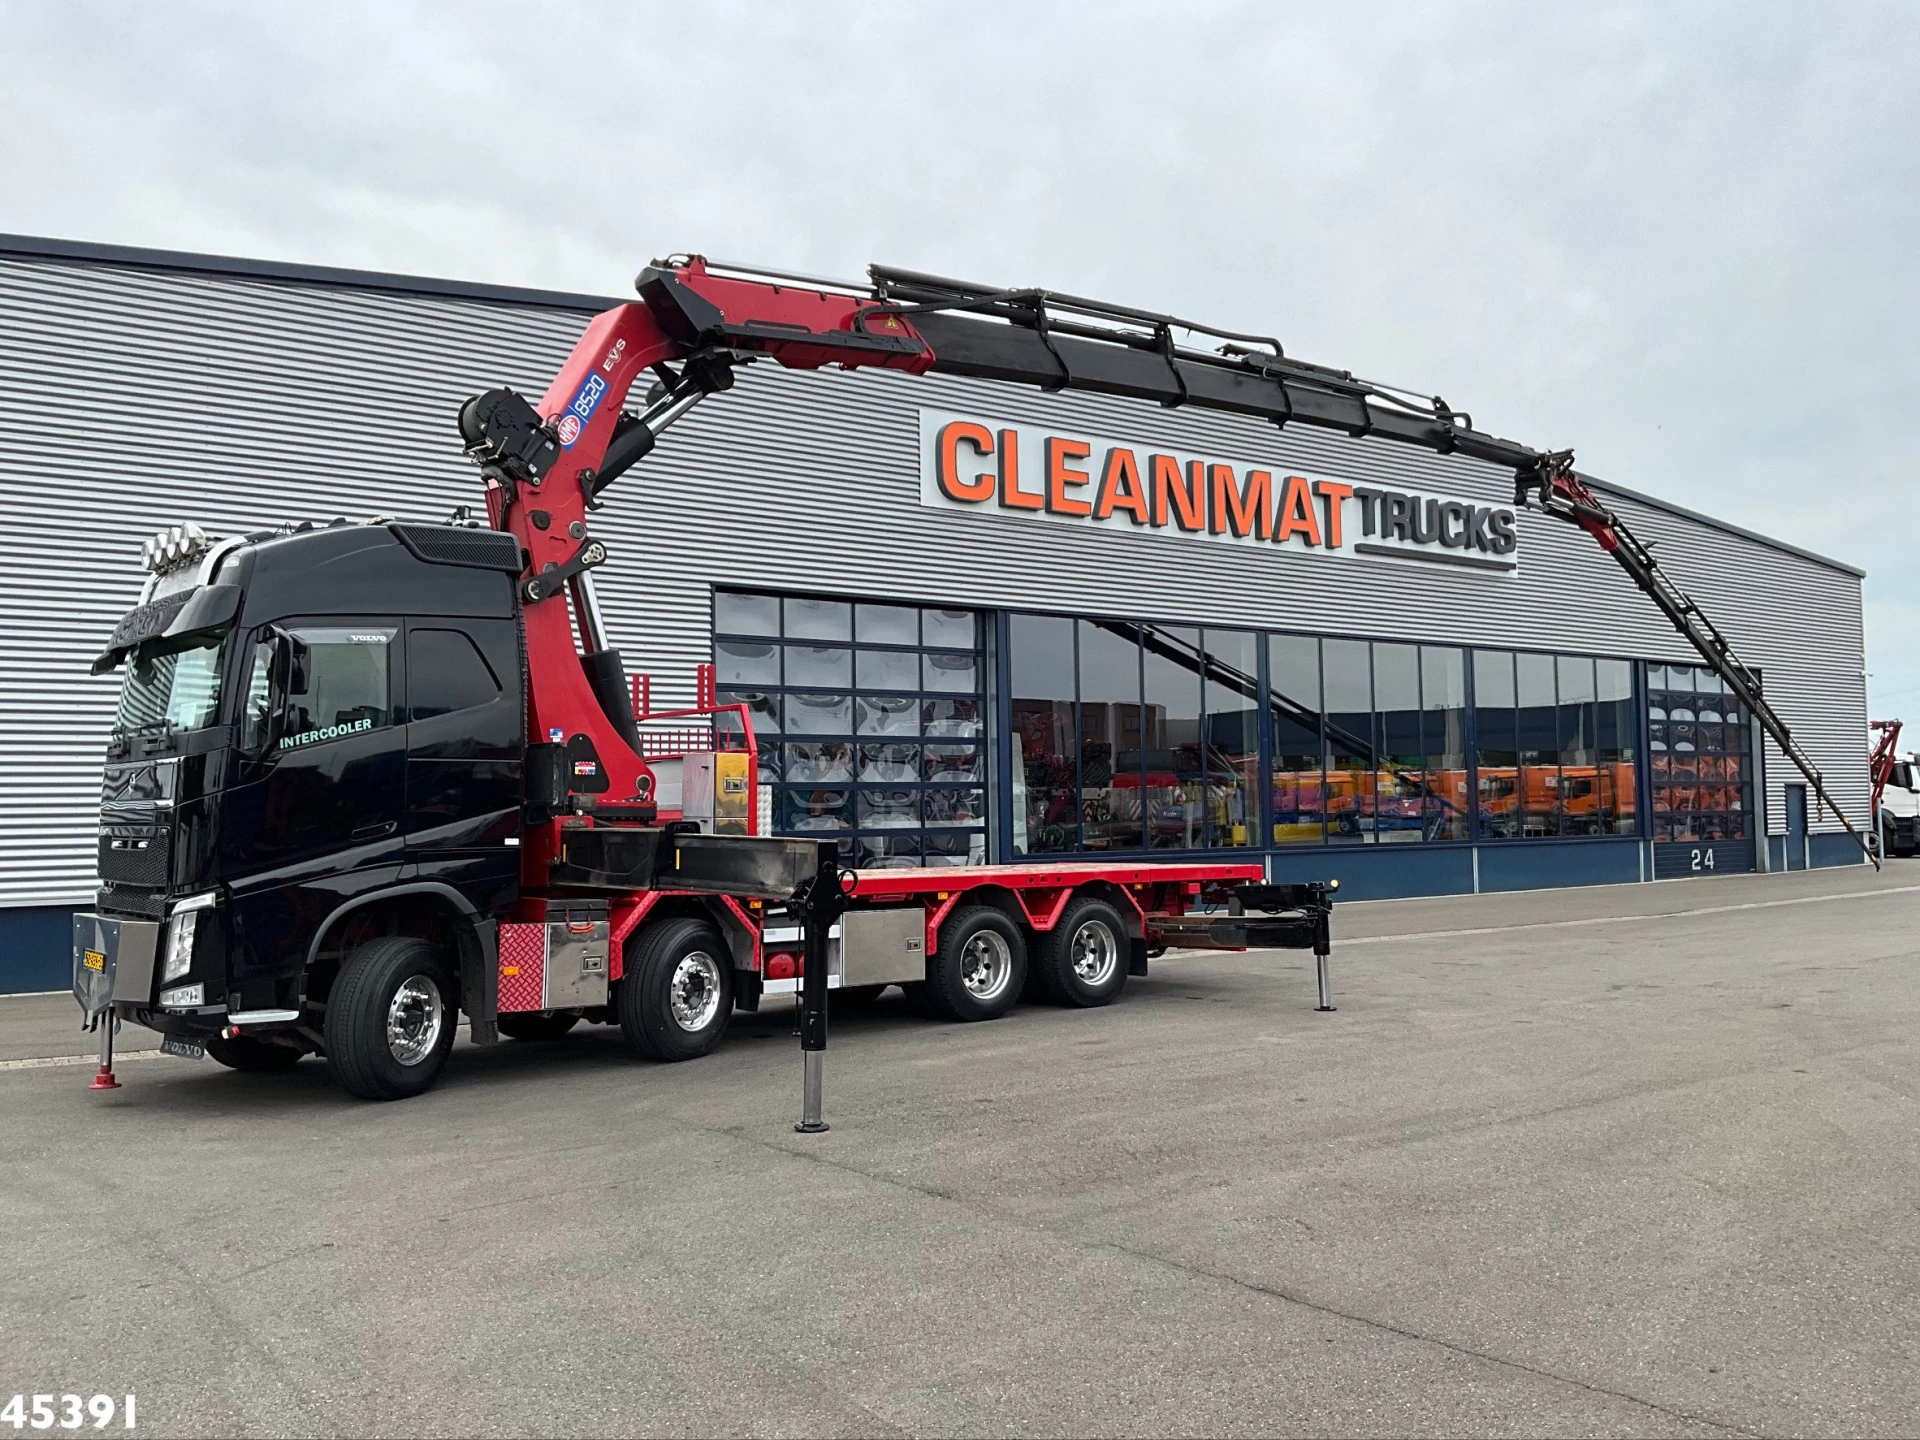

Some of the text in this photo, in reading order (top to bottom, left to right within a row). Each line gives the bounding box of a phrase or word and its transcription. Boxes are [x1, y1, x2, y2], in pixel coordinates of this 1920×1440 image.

[602, 338, 626, 372] EVS
[559, 374, 606, 443] HMF 8520
[935, 421, 1517, 554] CLEANMAT TRUCKS
[350, 634, 388, 642] VOLVO
[280, 718, 372, 749] INTERCOOLER
[1691, 848, 1715, 870] 24
[164, 1040, 202, 1057] VOLVO
